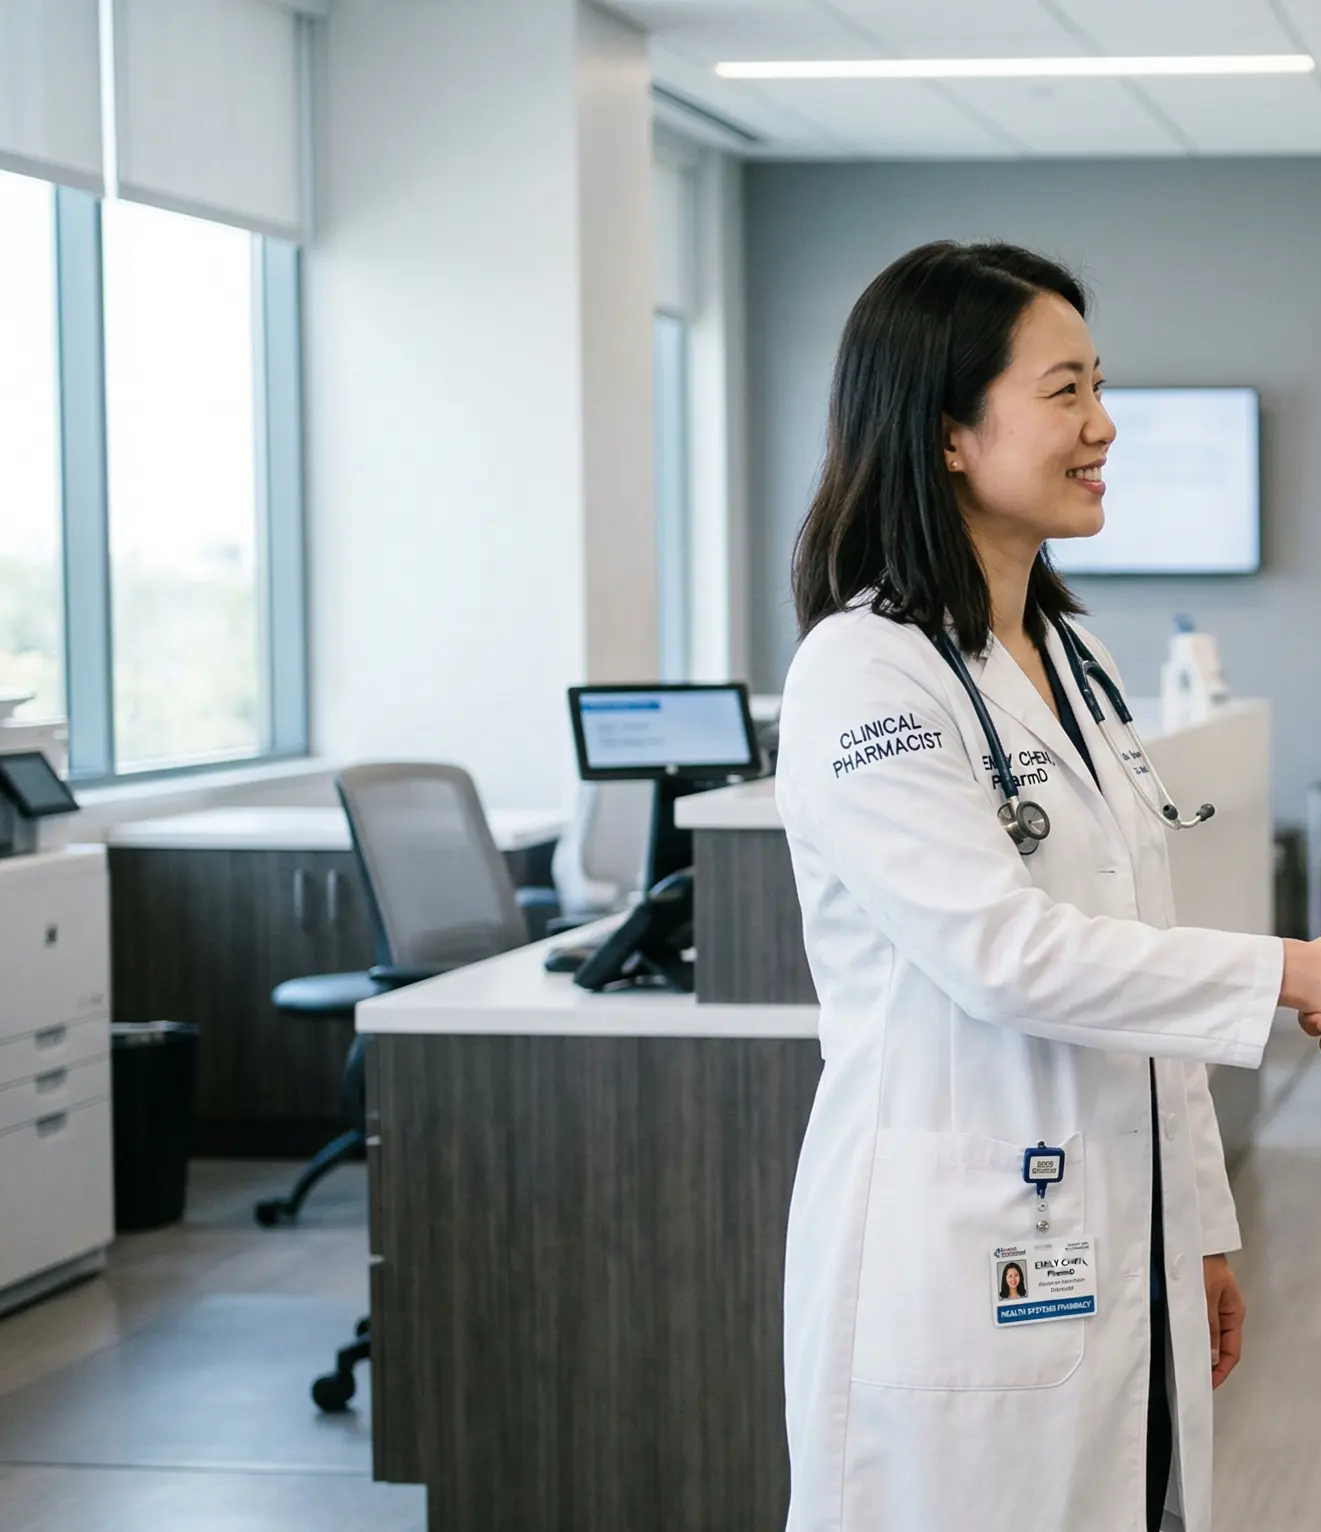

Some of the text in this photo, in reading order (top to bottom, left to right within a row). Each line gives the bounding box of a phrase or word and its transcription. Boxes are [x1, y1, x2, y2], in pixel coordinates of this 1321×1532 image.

[840, 713, 922, 749] CLINICAL
[833, 732, 942, 779] PHARMACIST
[992, 768, 1048, 790] ParmD
